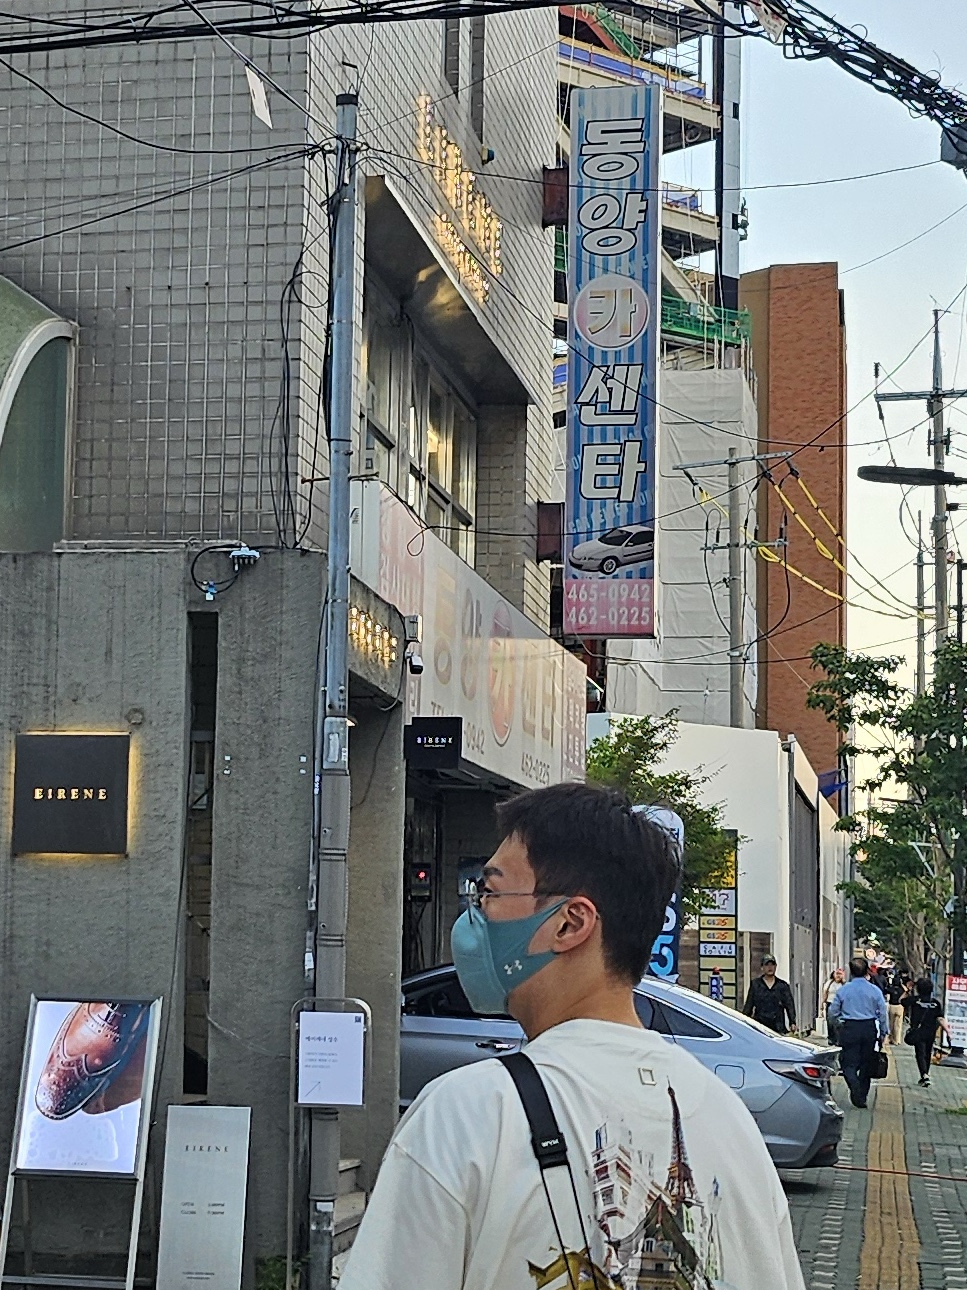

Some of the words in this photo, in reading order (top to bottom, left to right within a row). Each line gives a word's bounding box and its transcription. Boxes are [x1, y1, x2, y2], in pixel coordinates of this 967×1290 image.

[568, 583, 651, 603] 465-0942
[568, 605, 651, 626] 462-0225
[33, 787, 108, 800] EIRENE
[706, 917, 729, 927] GS25
[706, 931, 729, 941] GS25
[184, 1144, 229, 1153] EIRENE
